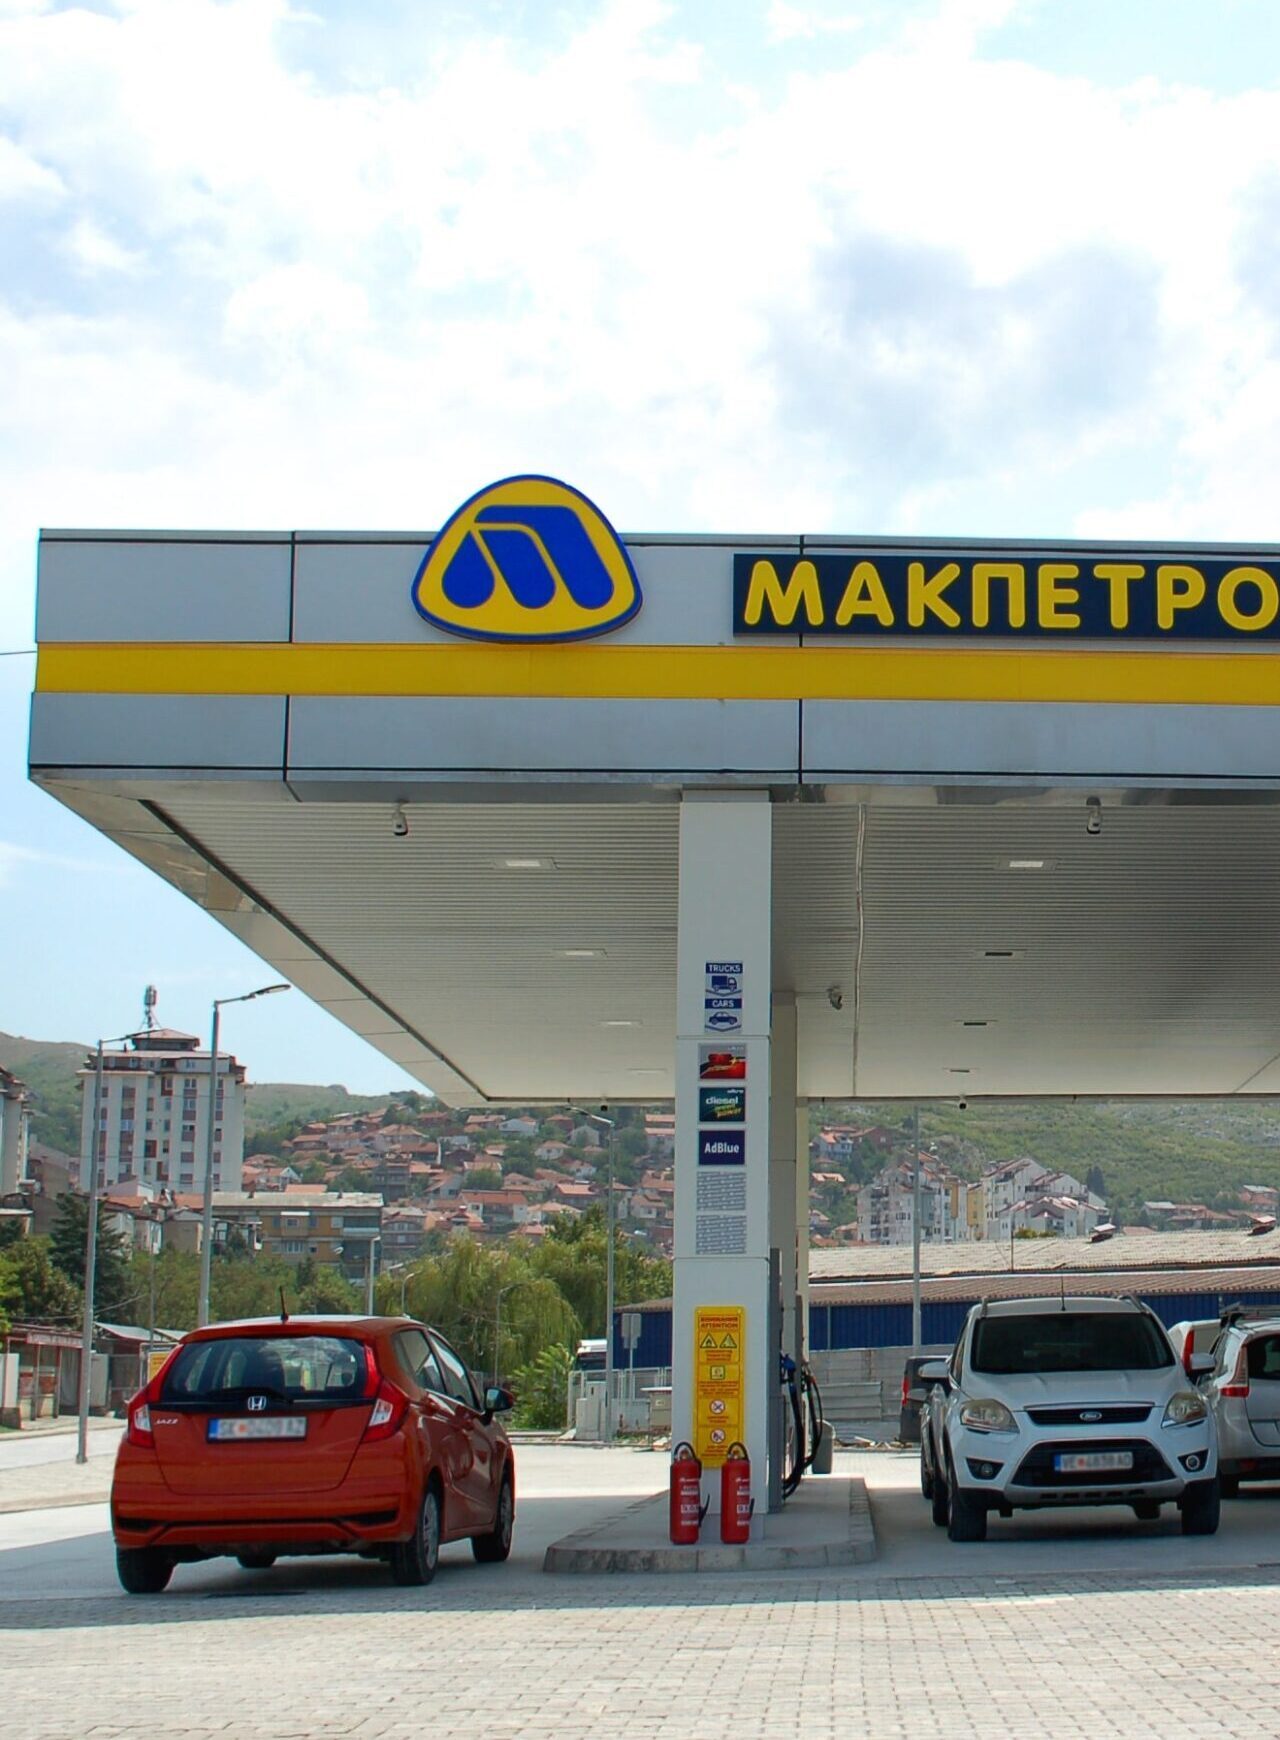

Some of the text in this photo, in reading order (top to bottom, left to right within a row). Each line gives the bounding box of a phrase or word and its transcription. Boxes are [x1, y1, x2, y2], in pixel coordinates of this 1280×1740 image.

[708, 964, 741, 973] TRUCKS
[712, 999, 735, 1008] CARS
[704, 1141, 740, 1154] AdBlue
